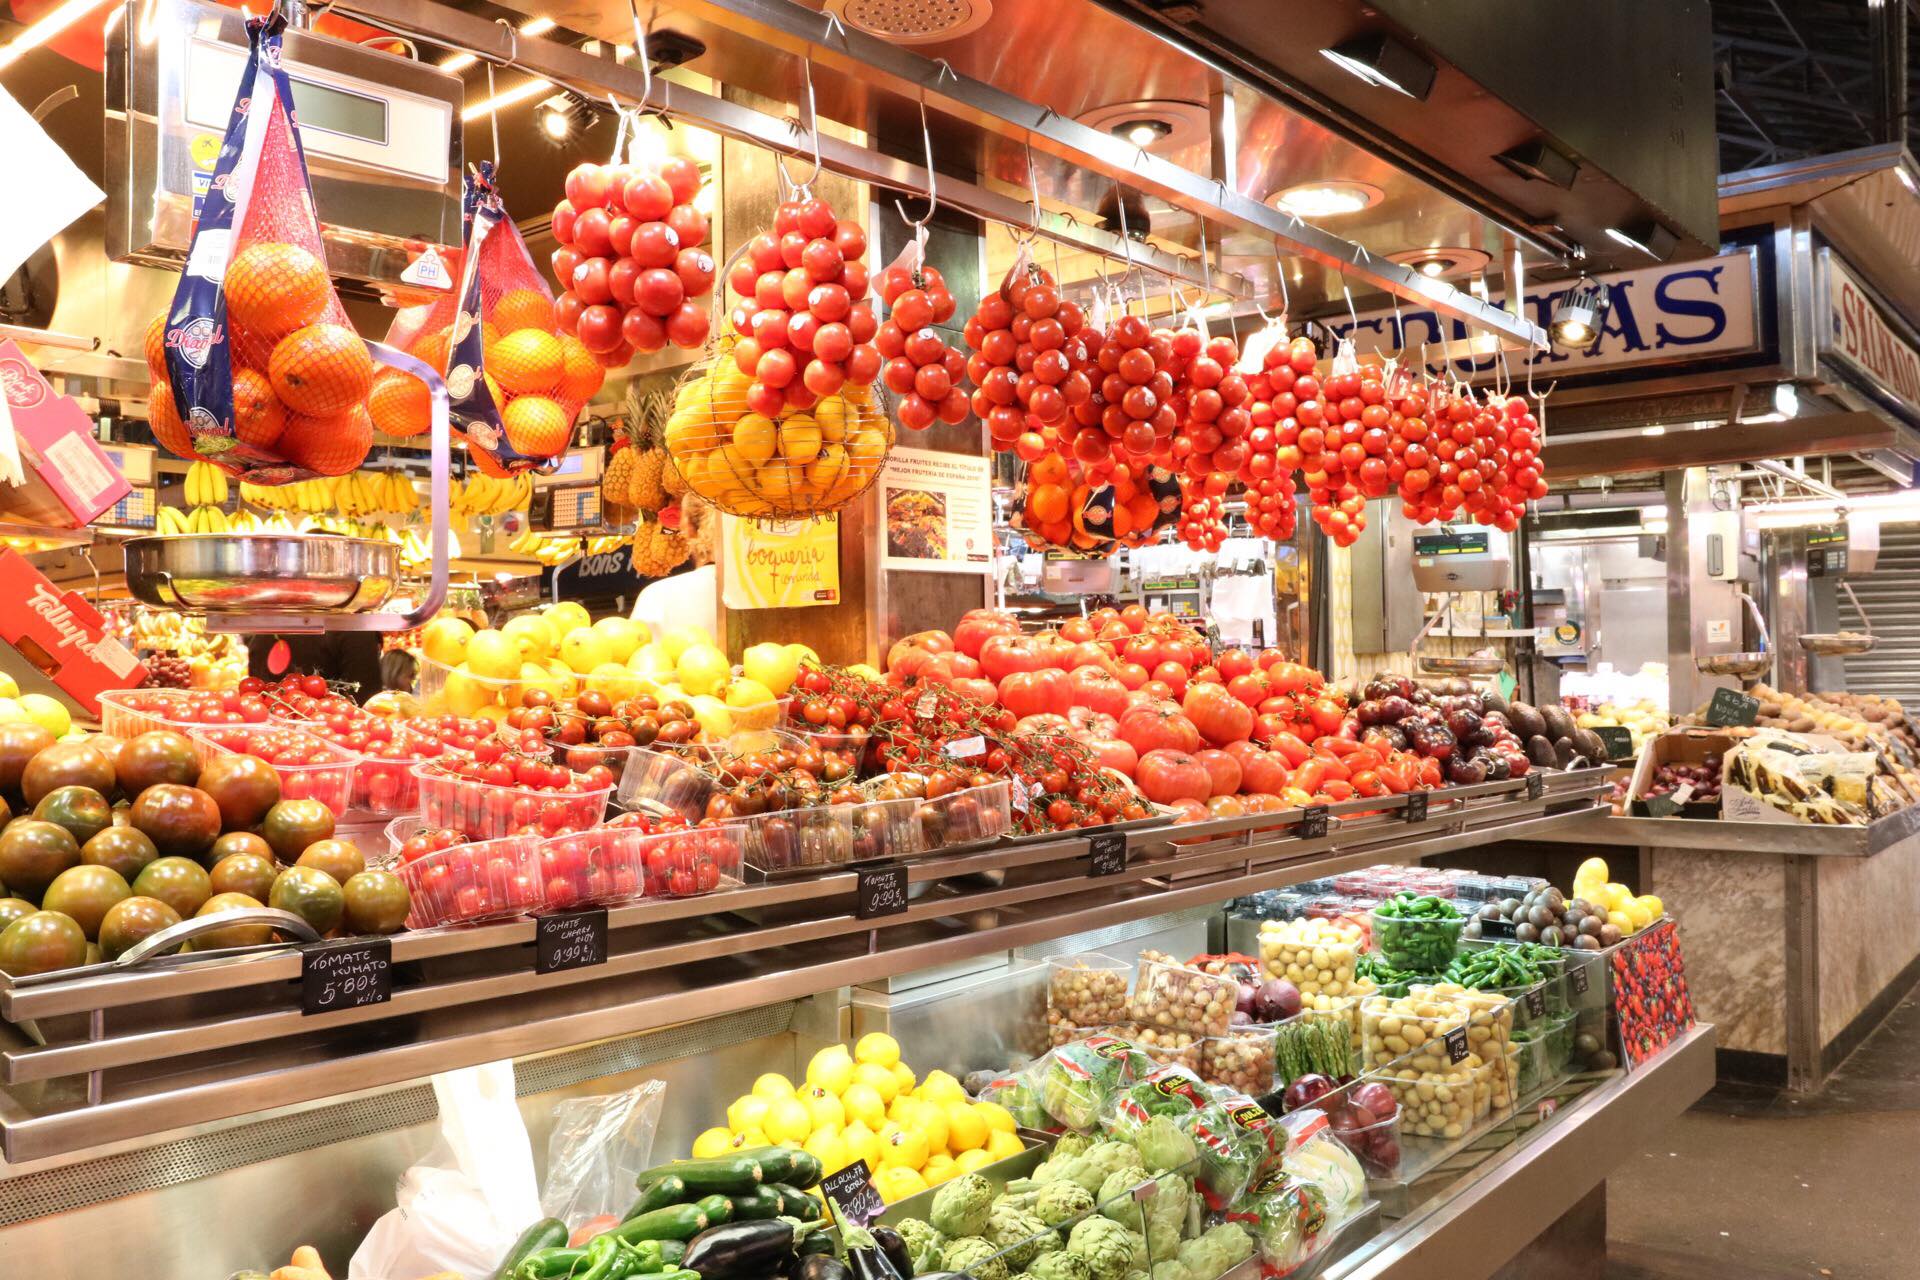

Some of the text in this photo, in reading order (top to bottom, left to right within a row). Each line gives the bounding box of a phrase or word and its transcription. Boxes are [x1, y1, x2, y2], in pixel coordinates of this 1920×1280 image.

[420, 265, 436, 277] PH
[864, 873, 895, 887] TOMATE
[544, 918, 582, 933] TOMATE
[561, 925, 591, 940] CHERRY
[309, 951, 371, 970] TOMATE
[332, 961, 387, 977] KUMATO
